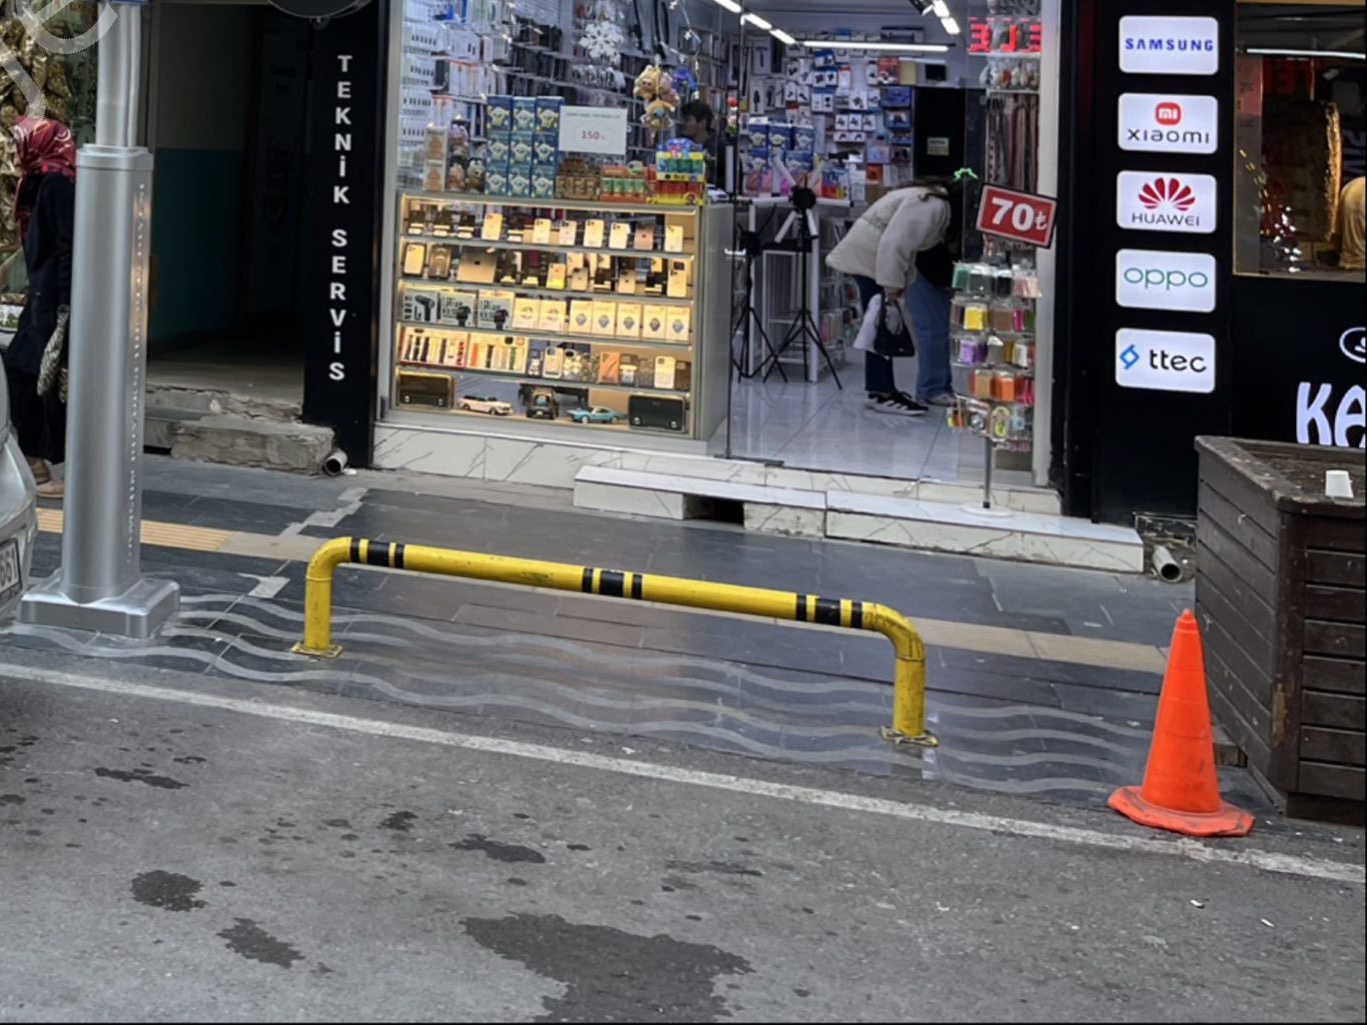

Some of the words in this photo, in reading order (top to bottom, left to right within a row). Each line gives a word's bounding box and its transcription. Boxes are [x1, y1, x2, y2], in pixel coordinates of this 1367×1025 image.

[1125, 37, 1214, 52] SAMSUNG
[332, 54, 352, 205] TEKNİK
[581, 130, 601, 141] 150
[1126, 128, 1210, 144] xiaomi
[1131, 212, 1200, 227] HUAWEI
[1124, 266, 1208, 291] oppo
[328, 228, 348, 382] SERVİS
[1148, 349, 1207, 373] ttec
